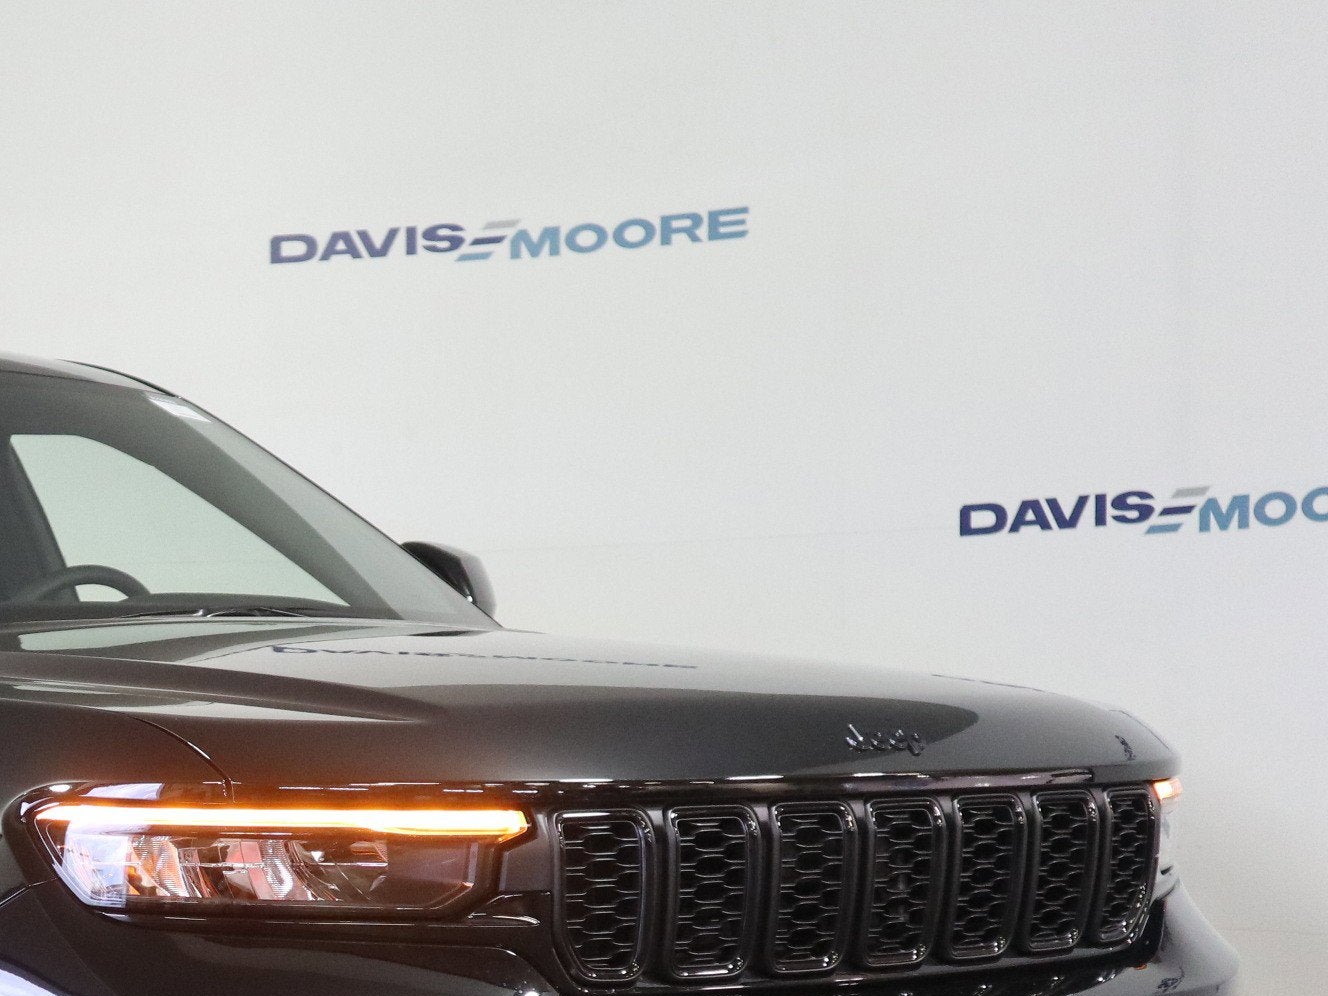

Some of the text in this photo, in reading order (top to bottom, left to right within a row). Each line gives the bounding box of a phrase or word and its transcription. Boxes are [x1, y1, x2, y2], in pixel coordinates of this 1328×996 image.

[269, 206, 750, 264] DAVIS MOORE
[958, 490, 1156, 537] DAVIS
[844, 722, 925, 757] Jeep
